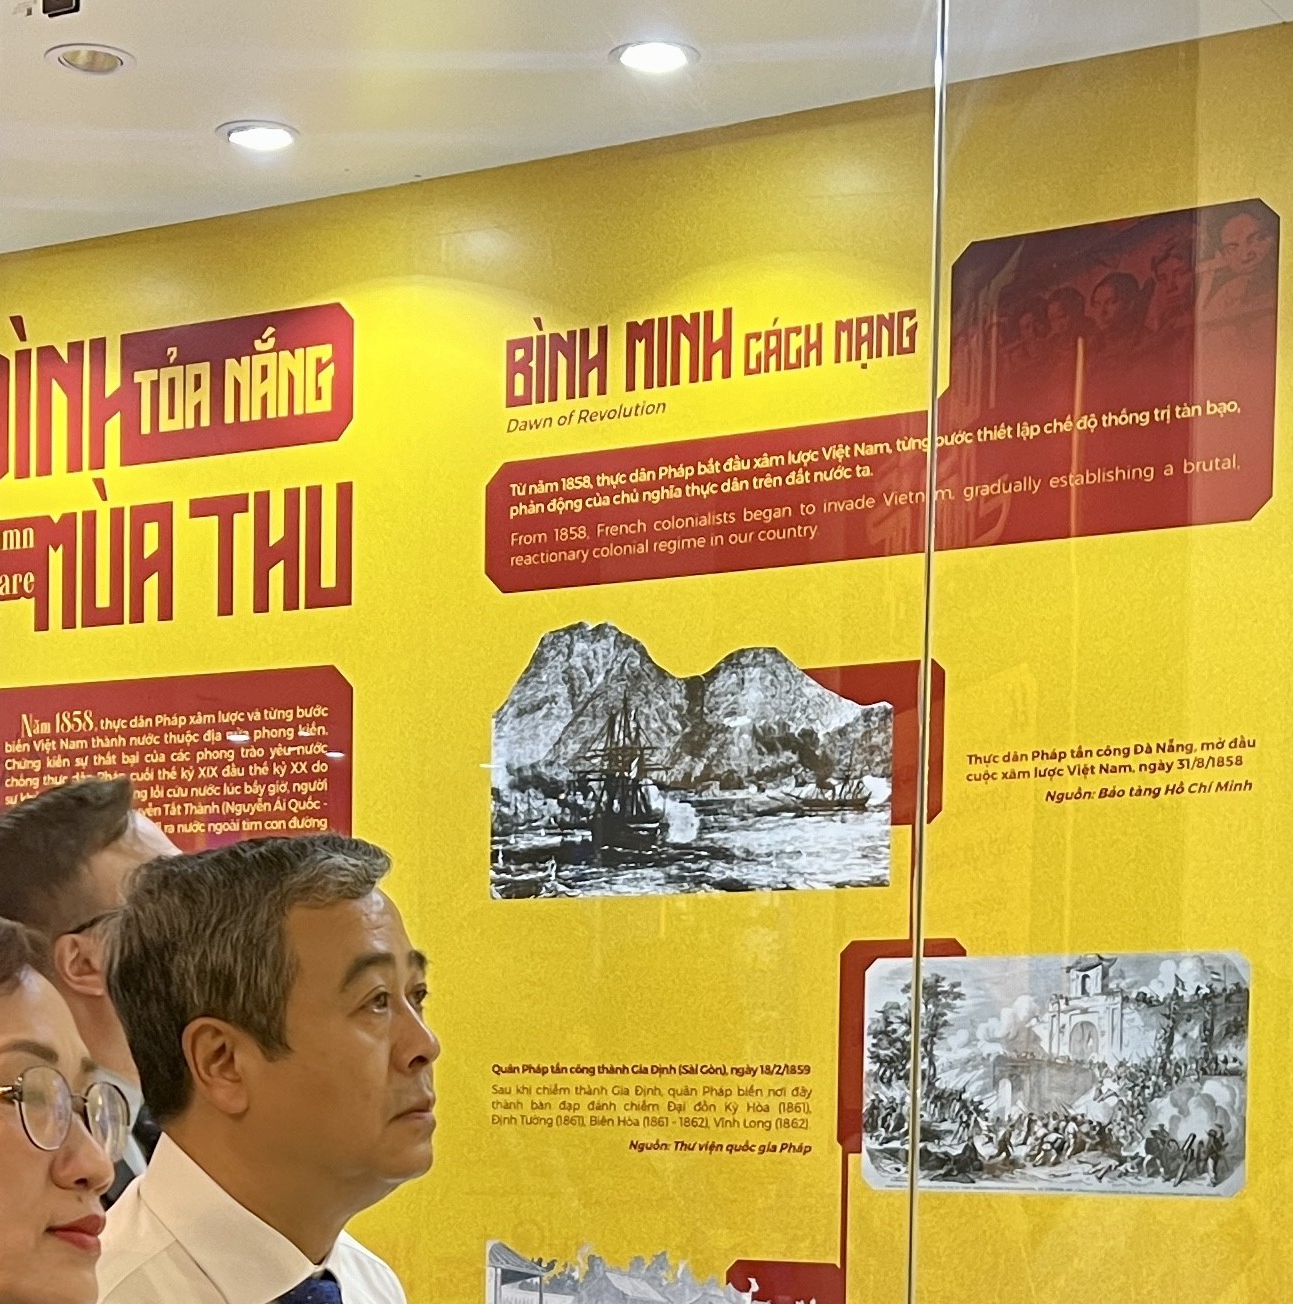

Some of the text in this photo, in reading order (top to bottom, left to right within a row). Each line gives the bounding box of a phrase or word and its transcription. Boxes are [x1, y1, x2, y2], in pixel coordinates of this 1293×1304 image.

[132, 346, 211, 435] TỎA
[224, 325, 336, 426] NẮNG
[505, 306, 918, 408] BÌNH MINH CÁCH MẠNG
[505, 400, 666, 433] Dawn of Revolution
[509, 482, 527, 496] Từ
[528, 479, 559, 495] năm
[595, 471, 627, 489] thực
[628, 467, 656, 483] dân
[658, 463, 695, 480] Pháp
[696, 457, 721, 476] bắt
[722, 454, 751, 472] đầu
[752, 452, 785, 469] xâm
[787, 448, 819, 466] lược
[821, 443, 851, 463] Việt
[976, 421, 1013, 442] thiết
[1016, 421, 1041, 441] lập
[1043, 413, 1074, 434] chế
[1075, 412, 1099, 434] độ
[1100, 407, 1150, 428] thống
[1153, 403, 1170, 424] trị
[1174, 402, 1202, 419] tàn
[509, 499, 545, 519] phản
[546, 496, 583, 515] động
[584, 492, 610, 508] của
[612, 486, 639, 505] chủ
[642, 484, 682, 504] nghĩa
[684, 481, 718, 499] thực
[720, 476, 749, 493] dân
[751, 472, 782, 490] trên
[784, 467, 811, 486] đất
[813, 464, 852, 482] nước
[510, 531, 547, 546] From
[596, 518, 646, 537] French
[652, 511, 736, 531] colonialists
[742, 505, 792, 523] began
[799, 502, 816, 516] to
[822, 494, 876, 513] invade
[882, 488, 956, 507] Vietnm,
[962, 475, 1041, 502] gradually
[1048, 465, 1154, 490] establishing
[1163, 463, 1174, 476] a
[33, 476, 354, 632] MÙA THU
[510, 548, 589, 566] reactionary
[591, 538, 649, 558] colonial
[652, 536, 706, 554] regime
[709, 534, 724, 546] in
[728, 531, 754, 545] our
[965, 769, 997, 784] cuộc
[1000, 769, 1030, 780] xâm
[1033, 766, 1064, 781] lược
[1066, 763, 1095, 779] Việt
[1137, 759, 1174, 774] ngày
[966, 753, 999, 765] Thực
[1001, 750, 1028, 763] dân
[1031, 748, 1067, 763] Pháp
[1069, 744, 1093, 759] tấn
[1095, 744, 1131, 758] công
[1133, 742, 1153, 755] Đà
[1200, 736, 1226, 751] mở
[1227, 734, 1256, 749] đầu
